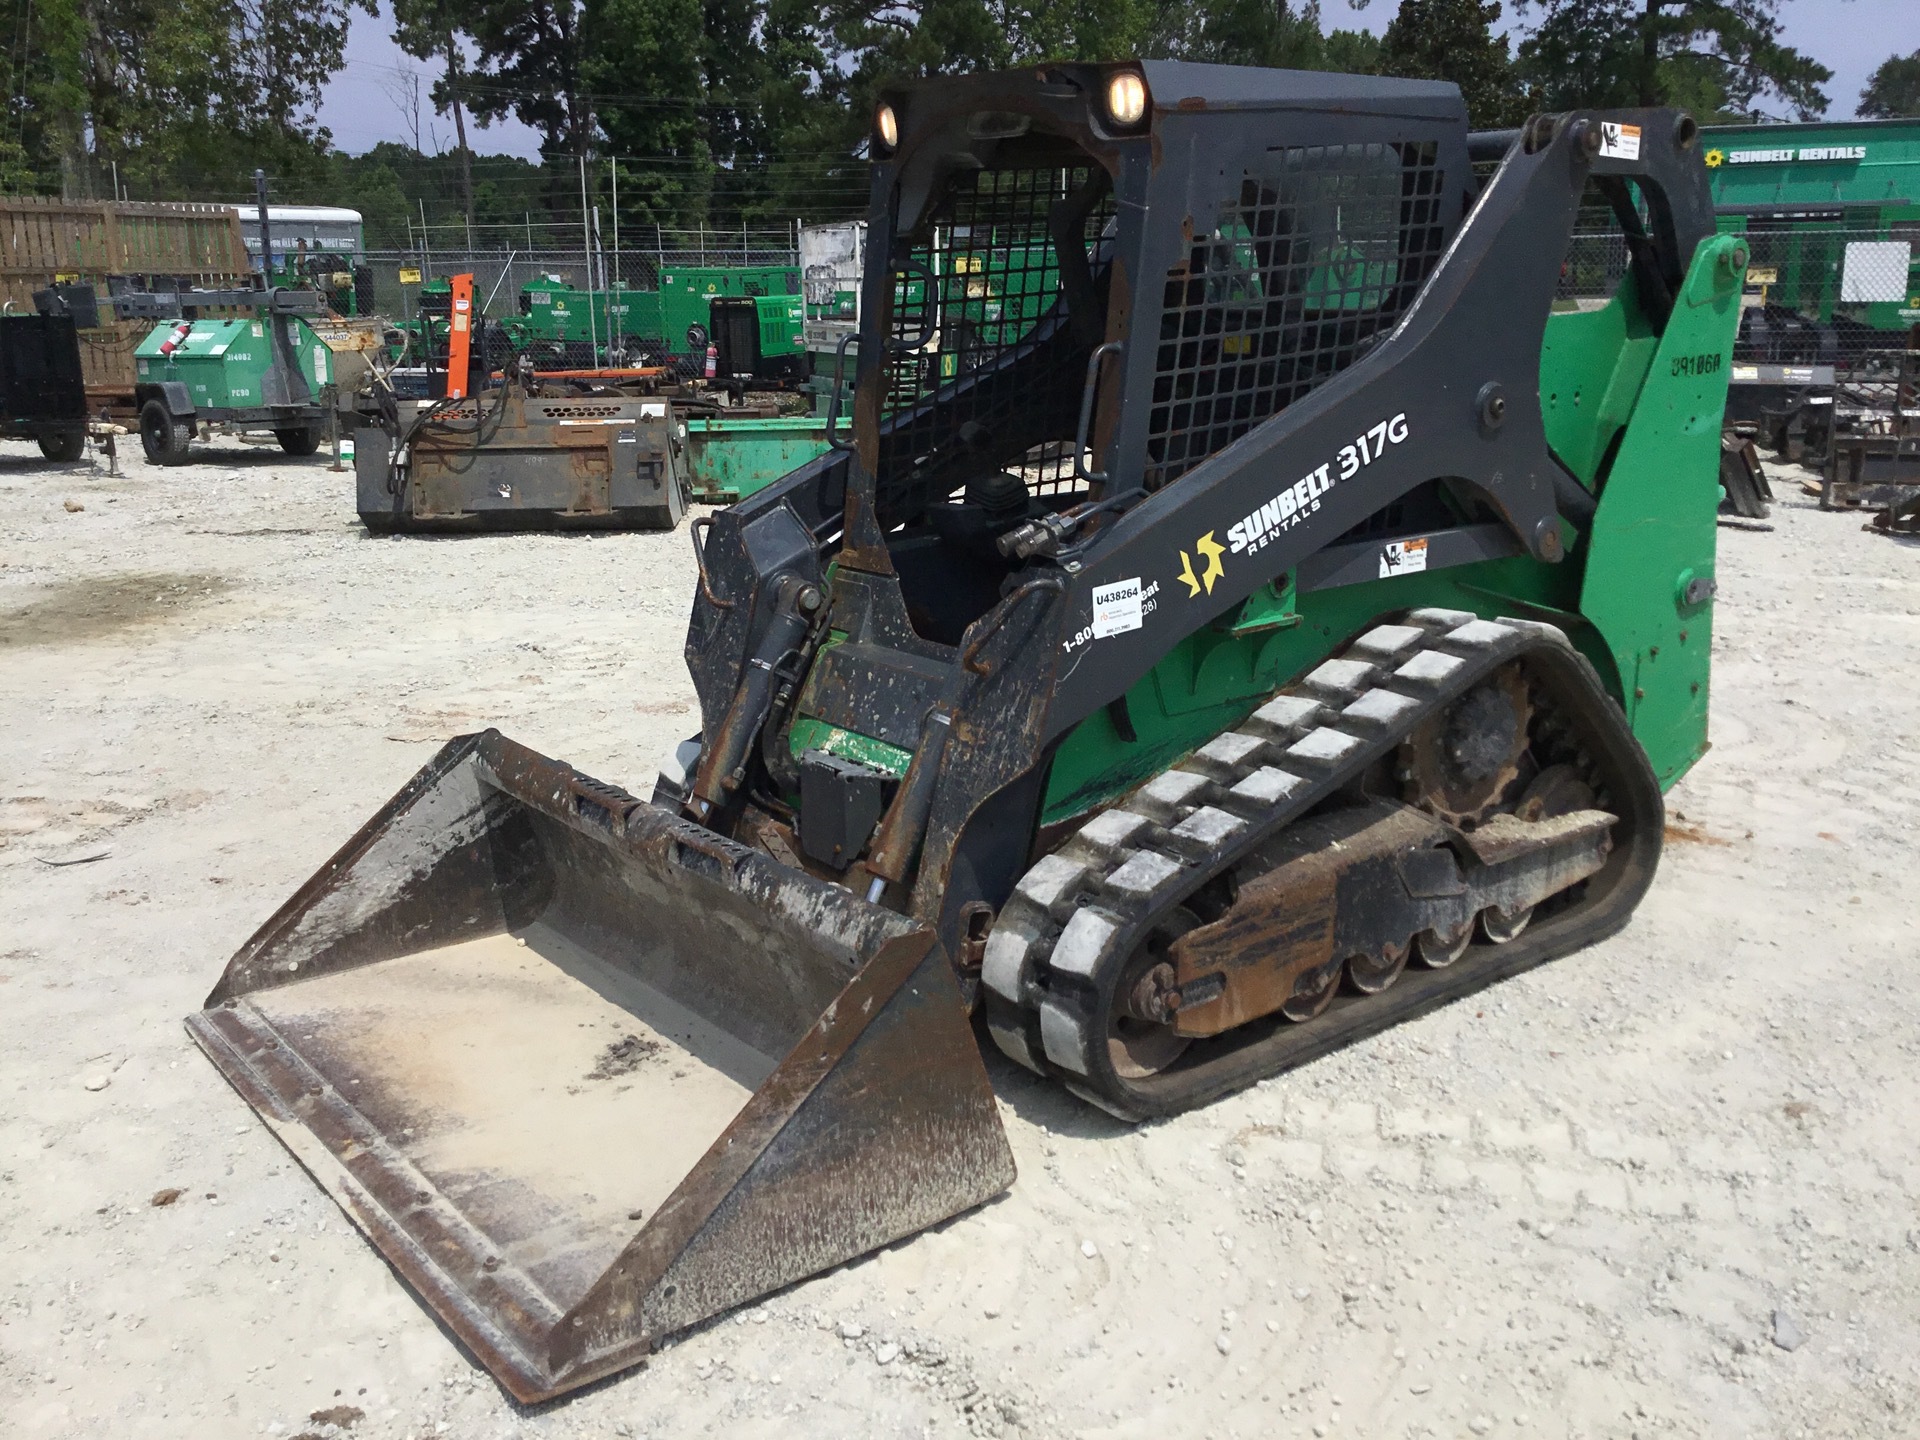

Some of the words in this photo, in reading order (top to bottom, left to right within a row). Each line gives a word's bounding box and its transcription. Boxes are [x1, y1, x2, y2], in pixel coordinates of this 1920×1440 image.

[1729, 149, 1795, 163] SUNBELT
[1798, 146, 1867, 161] RENTALS
[226, 353, 252, 361] 314082
[231, 388, 250, 397] PC90
[1227, 462, 1330, 554] SUNBELT
[1336, 412, 1409, 481] 317G
[1247, 499, 1321, 556] RENTALS
[1096, 586, 1138, 606] U438264
[1141, 598, 1158, 617] 28)
